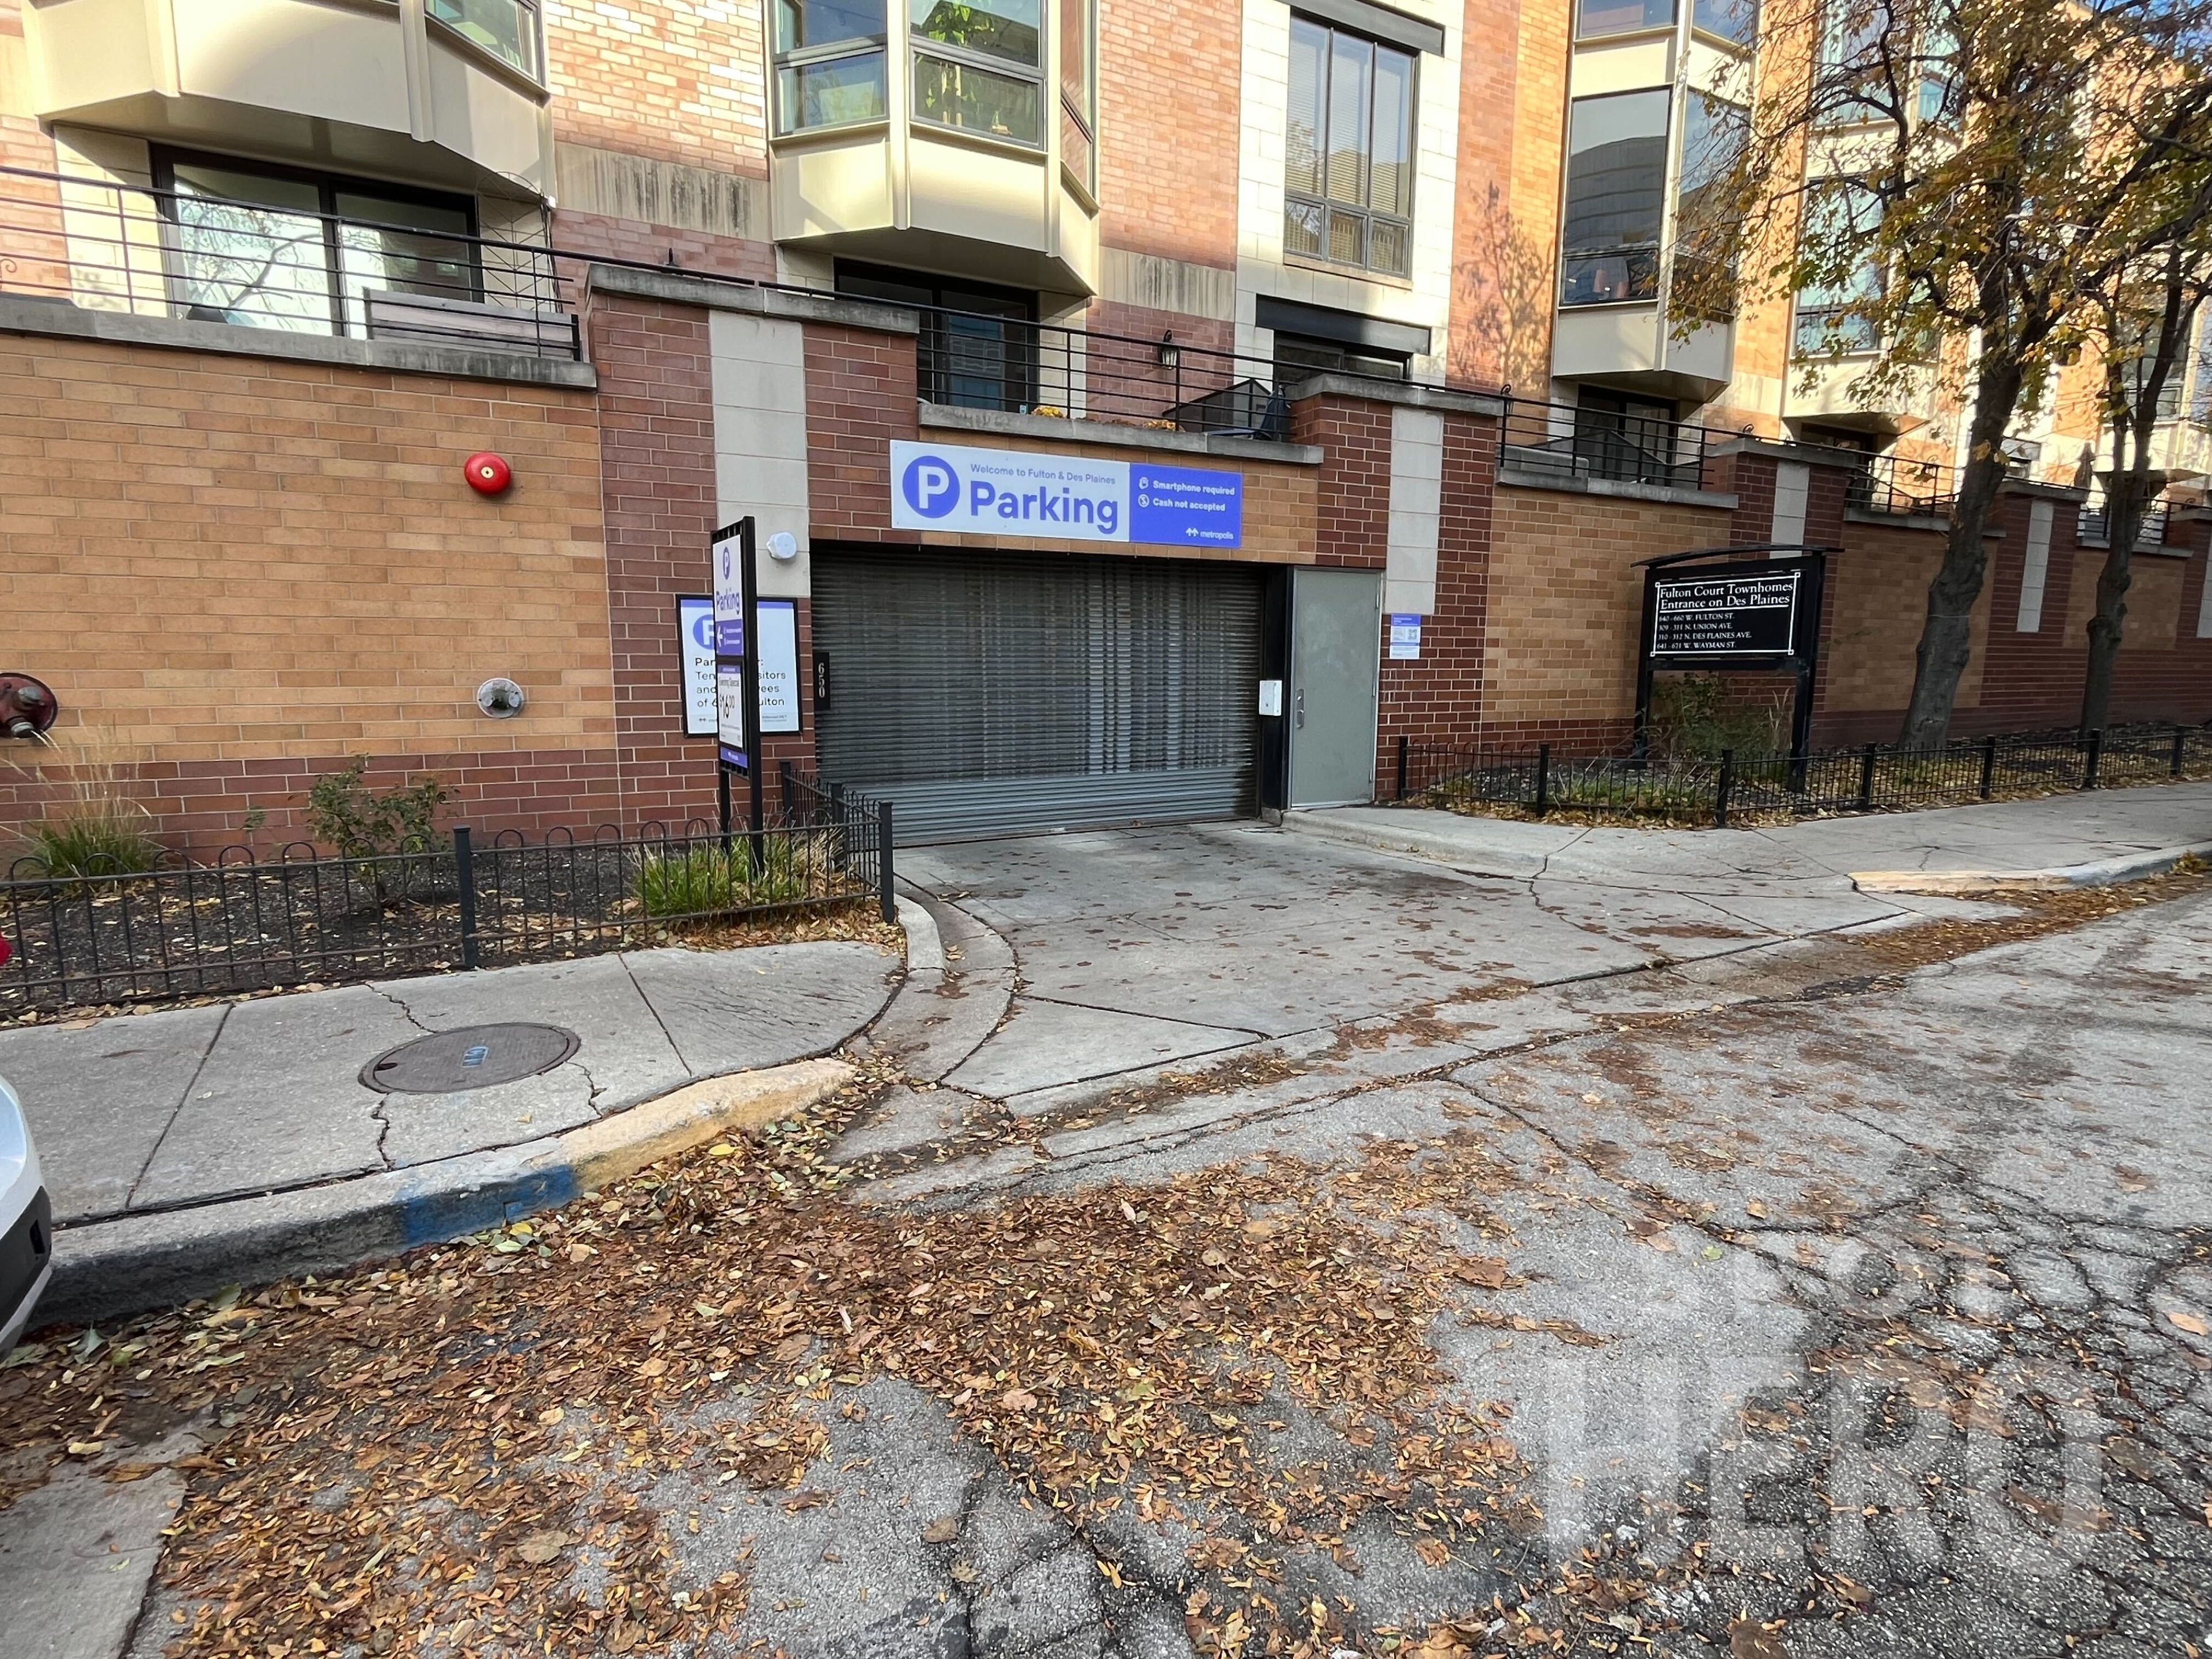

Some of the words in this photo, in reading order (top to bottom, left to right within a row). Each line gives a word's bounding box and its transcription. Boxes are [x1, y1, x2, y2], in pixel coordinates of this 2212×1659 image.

[970, 463, 1014, 475] Welcome
[1016, 467, 1026, 476] to
[1028, 468, 1056, 479] Fulton
[1058, 471, 1065, 480] &
[1067, 472, 1083, 482] Des
[1085, 474, 1115, 484] Plaines
[918, 465, 949, 509] P
[1153, 480, 1201, 493] Smartphone
[1202, 486, 1235, 495] required
[970, 480, 1118, 535] Parking
[1153, 498, 1173, 507] Cash
[1190, 503, 1226, 512] accepted
[1200, 531, 1234, 540] metropolis
[1660, 588, 1691, 598] Fulton
[1694, 586, 1725, 596] Court
[1727, 582, 1793, 594] Townhomes
[716, 587, 740, 615] Parking
[1661, 599, 1706, 609] Entrance
[1727, 596, 1747, 606] Des
[1750, 593, 1790, 605] Plaines
[759, 671, 786, 679] sitors
[697, 698, 708, 707] of
[759, 697, 785, 706] ulton
